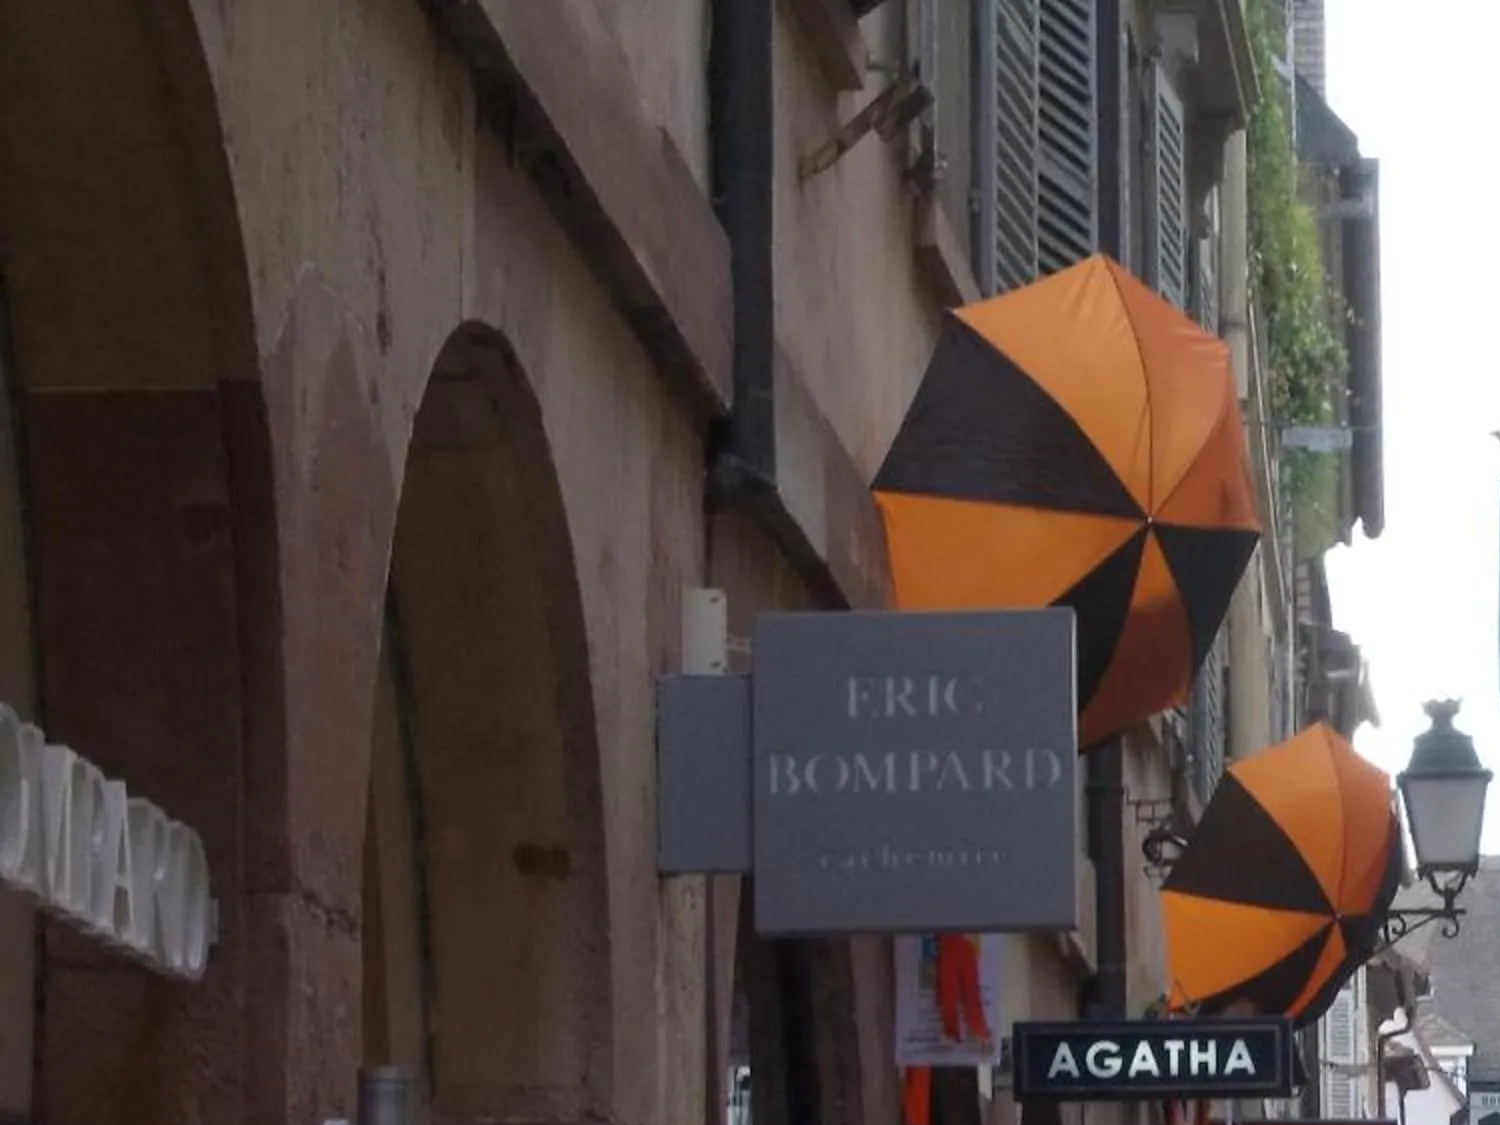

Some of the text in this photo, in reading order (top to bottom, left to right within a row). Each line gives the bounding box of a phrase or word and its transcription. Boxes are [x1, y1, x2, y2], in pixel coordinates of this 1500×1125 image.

[846, 674, 986, 719] ERIC
[767, 747, 1063, 796] BOMPARD
[1047, 1037, 1257, 1080] AGATHA
